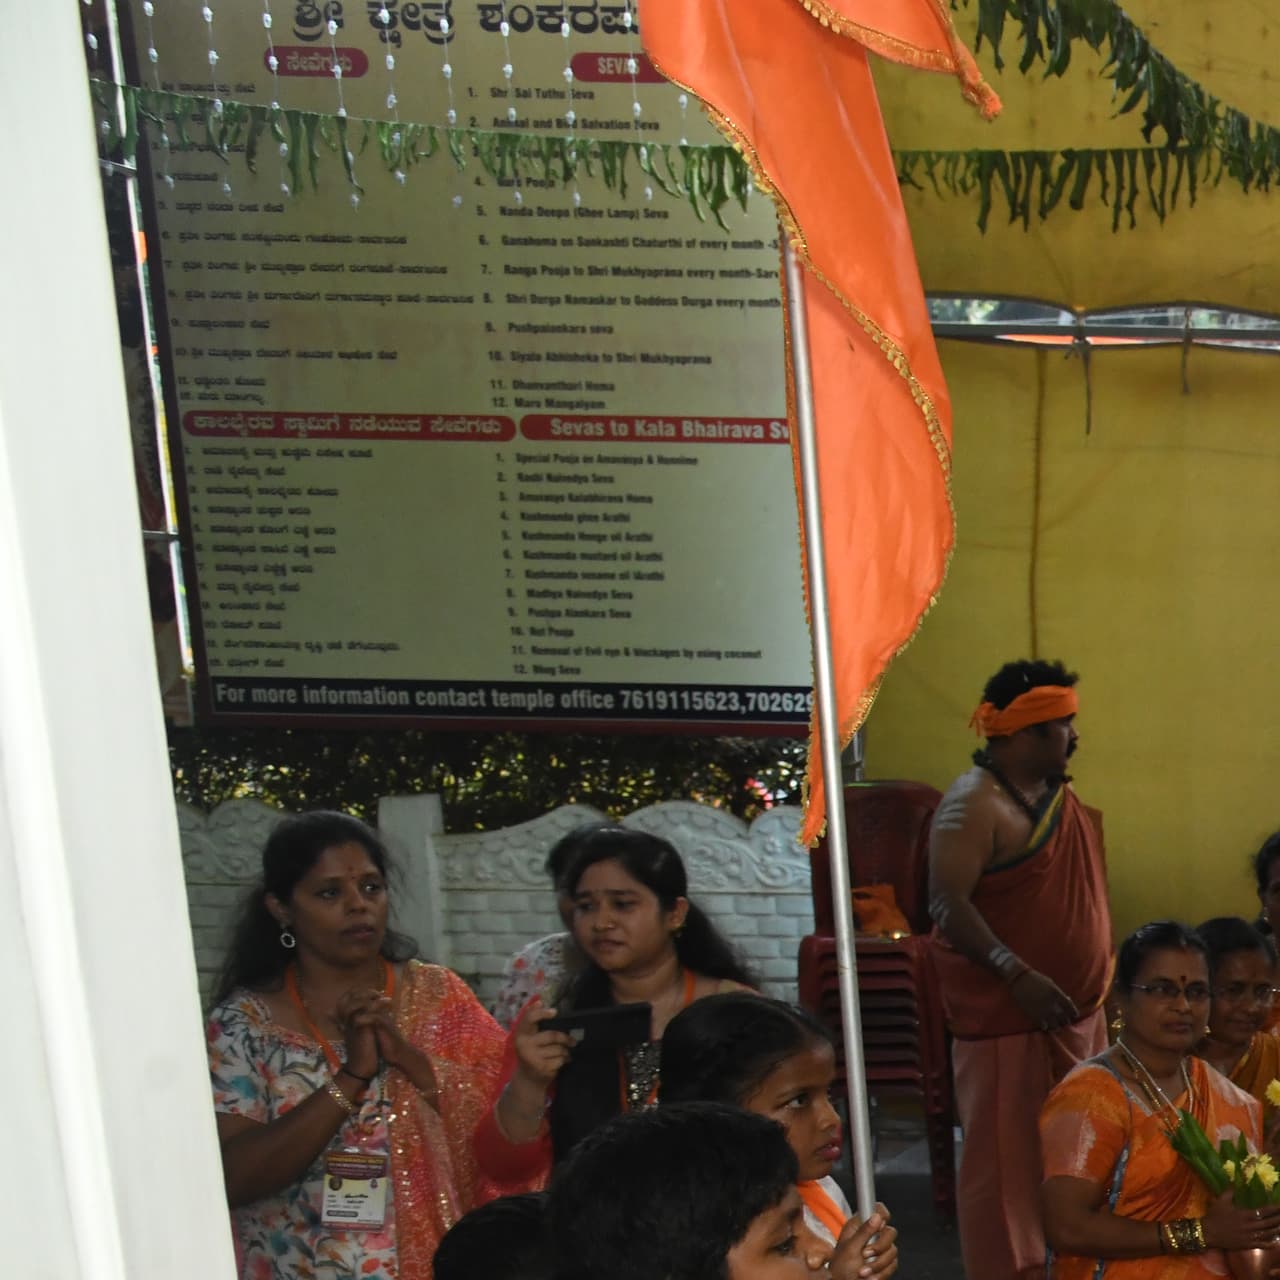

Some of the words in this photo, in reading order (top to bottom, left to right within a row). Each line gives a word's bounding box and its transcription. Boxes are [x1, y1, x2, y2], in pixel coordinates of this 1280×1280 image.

[550, 418, 605, 436] Sevas
[610, 420, 628, 437] to
[634, 420, 676, 438] Kala
[682, 420, 765, 439] Bhairava
[216, 684, 246, 703] For
[251, 687, 297, 704] more
[303, 685, 409, 706] information
[415, 689, 486, 707] contact
[491, 690, 554, 712] temple
[560, 690, 615, 710] office
[620, 690, 814, 715] 7619115623,702629
